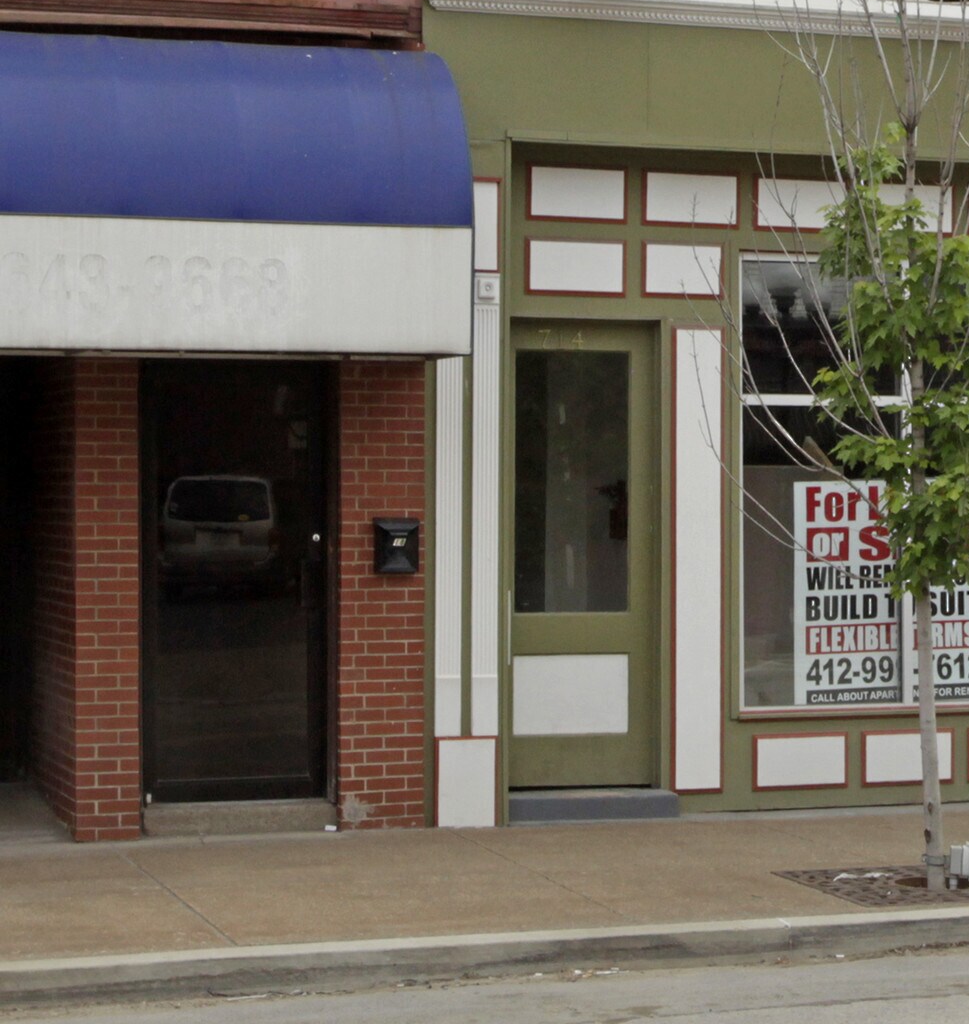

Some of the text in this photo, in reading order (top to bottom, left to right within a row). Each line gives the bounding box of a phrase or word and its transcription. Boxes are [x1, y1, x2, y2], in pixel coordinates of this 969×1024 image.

[806, 486, 861, 522] For
[812, 532, 845, 558] or
[806, 565, 853, 590] WILL
[806, 594, 878, 622] BUILD
[811, 693, 835, 703] CALL
[837, 691, 868, 702] ABOUT
